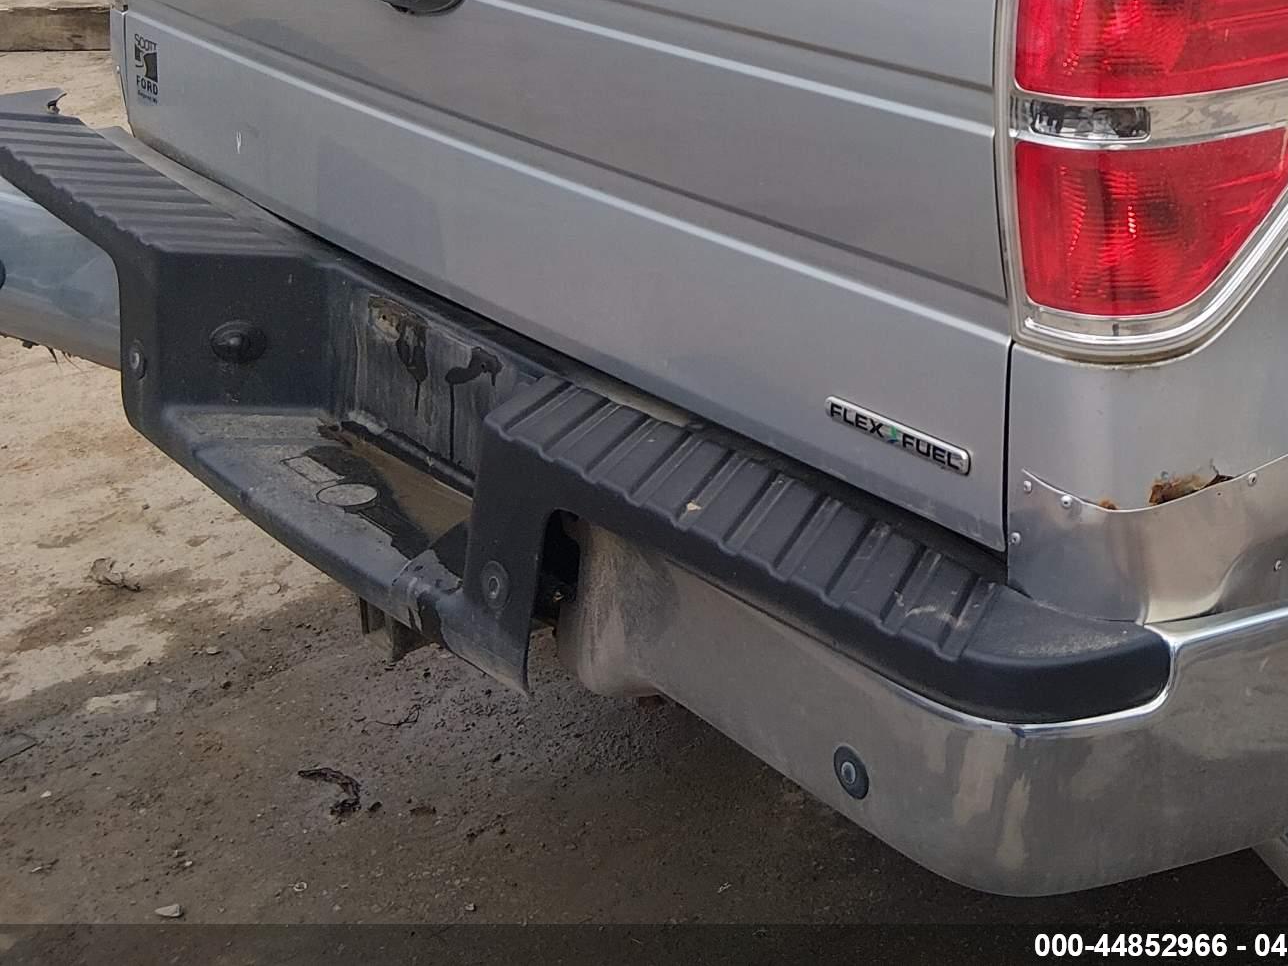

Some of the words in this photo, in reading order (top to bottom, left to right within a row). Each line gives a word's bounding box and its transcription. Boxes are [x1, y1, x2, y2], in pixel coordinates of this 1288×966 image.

[134, 34, 157, 52] SCOTT
[136, 75, 159, 96] FORD
[829, 402, 884, 439] FLEX
[902, 433, 961, 471] FUEL
